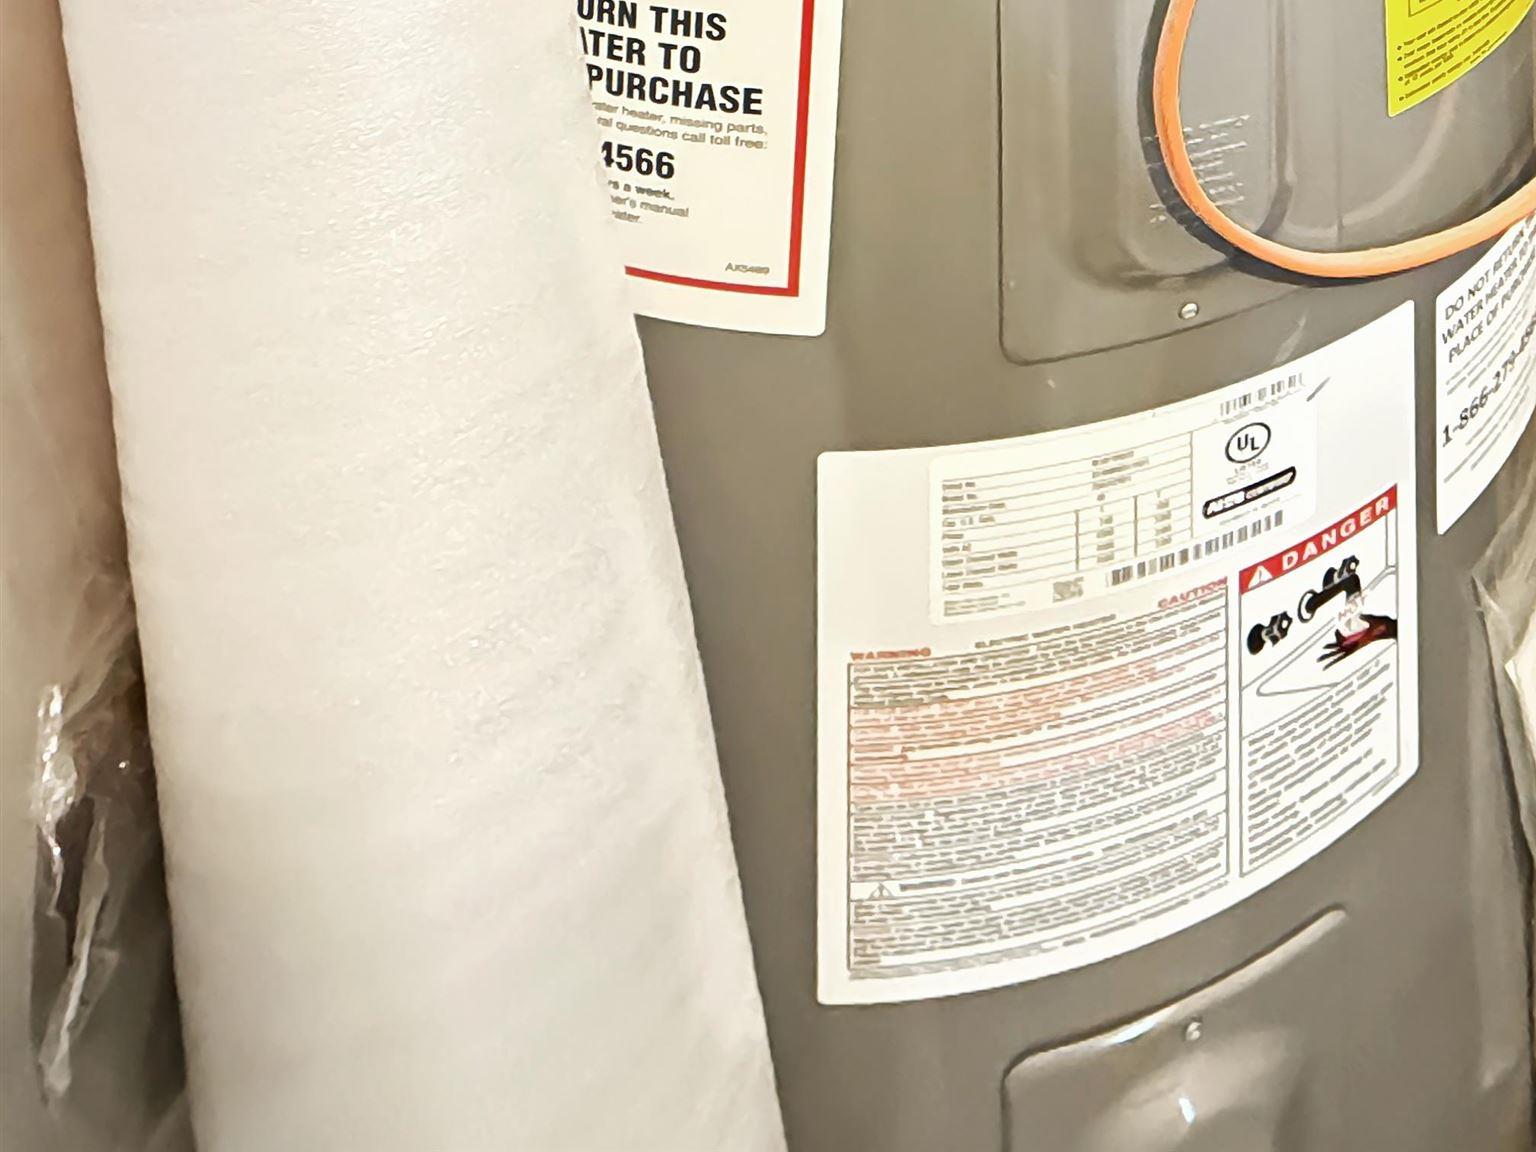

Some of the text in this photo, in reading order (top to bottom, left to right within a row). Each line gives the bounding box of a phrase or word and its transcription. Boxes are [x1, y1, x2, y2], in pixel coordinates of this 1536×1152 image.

[649, 5, 727, 41] THIS
[658, 42, 701, 74] TO
[587, 63, 764, 115] PURCHASE
[615, 121, 679, 140] questions
[682, 131, 706, 143] call
[710, 135, 731, 146] toll
[670, 116, 723, 133] missing
[640, 201, 690, 218] manual
[1444, 295, 1464, 321] DO
[1467, 271, 1490, 298] NOT
[1441, 300, 1484, 345] WATER
[1447, 322, 1485, 364] PLACE
[1236, 430, 1261, 454] UL
[1281, 494, 1391, 573] DANGER
[1157, 576, 1228, 609] CAUTION
